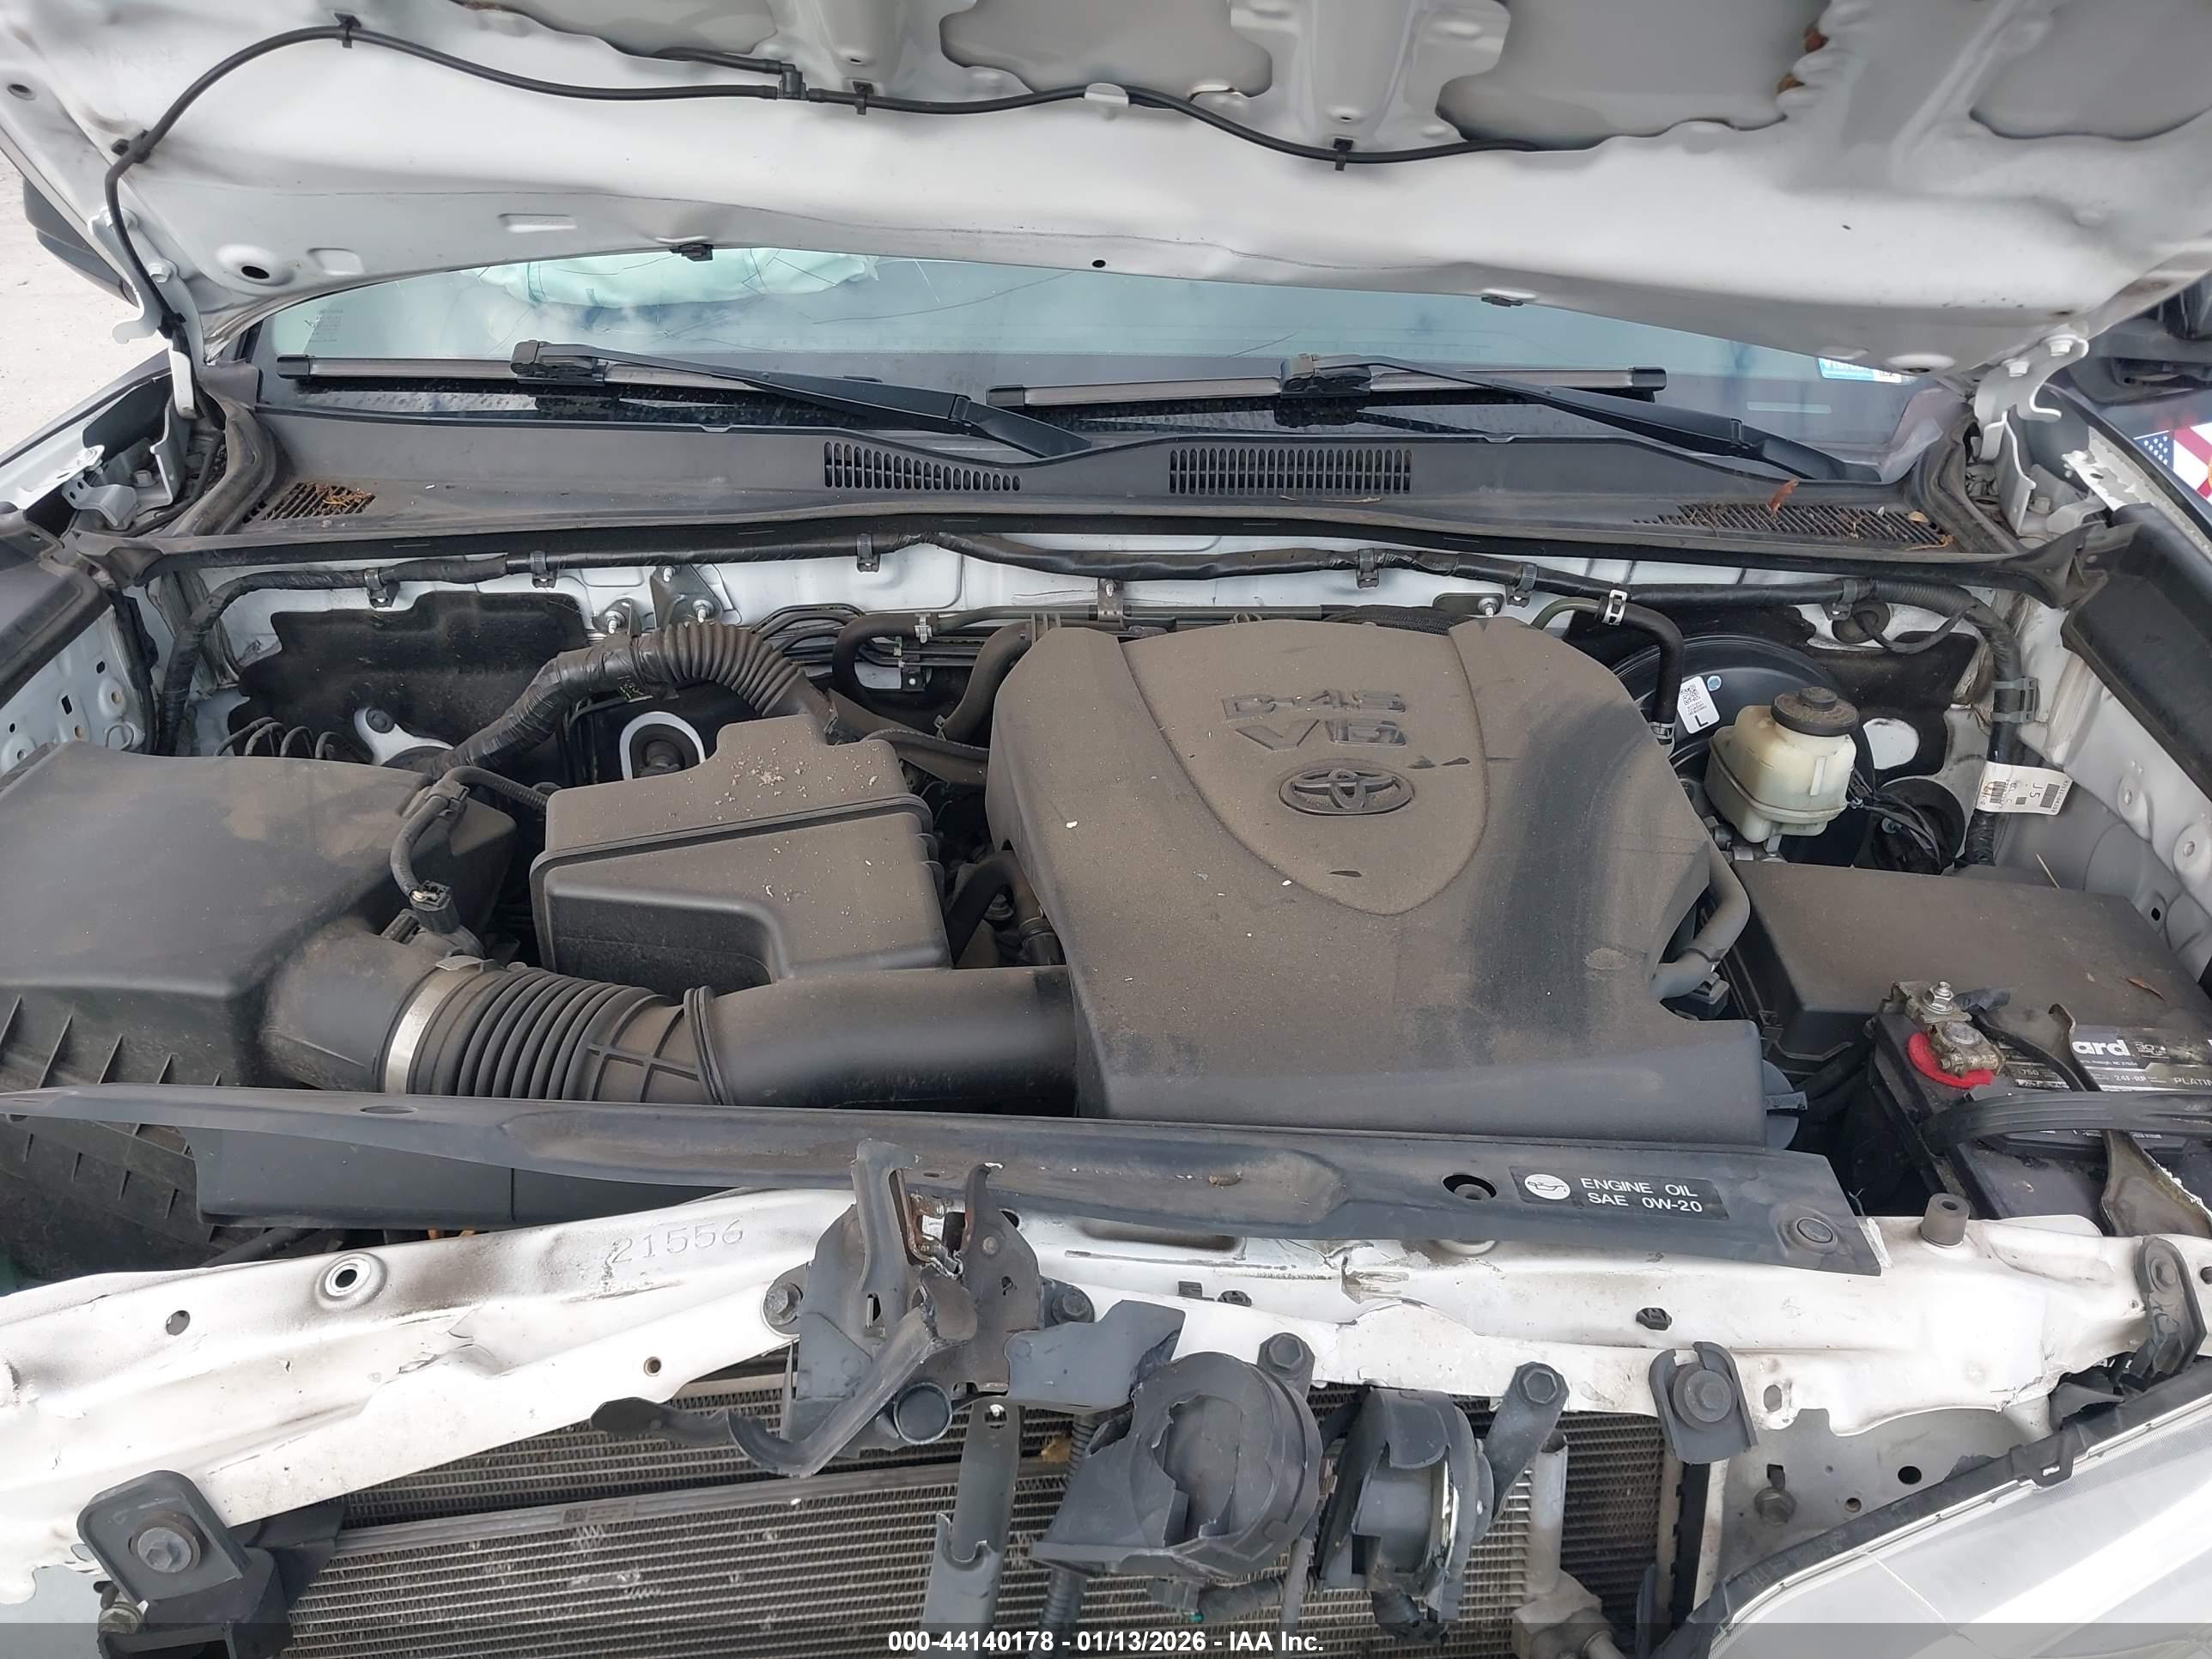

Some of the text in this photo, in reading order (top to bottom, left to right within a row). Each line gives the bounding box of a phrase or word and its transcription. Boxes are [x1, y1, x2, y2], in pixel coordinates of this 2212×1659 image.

[1694, 714, 1709, 727] L
[1234, 719, 1407, 751] V6
[1580, 1177, 1699, 1197] ENGINE OIL
[1587, 1192, 1704, 1213] SAE 0W-20
[610, 1215, 744, 1264] 21556
